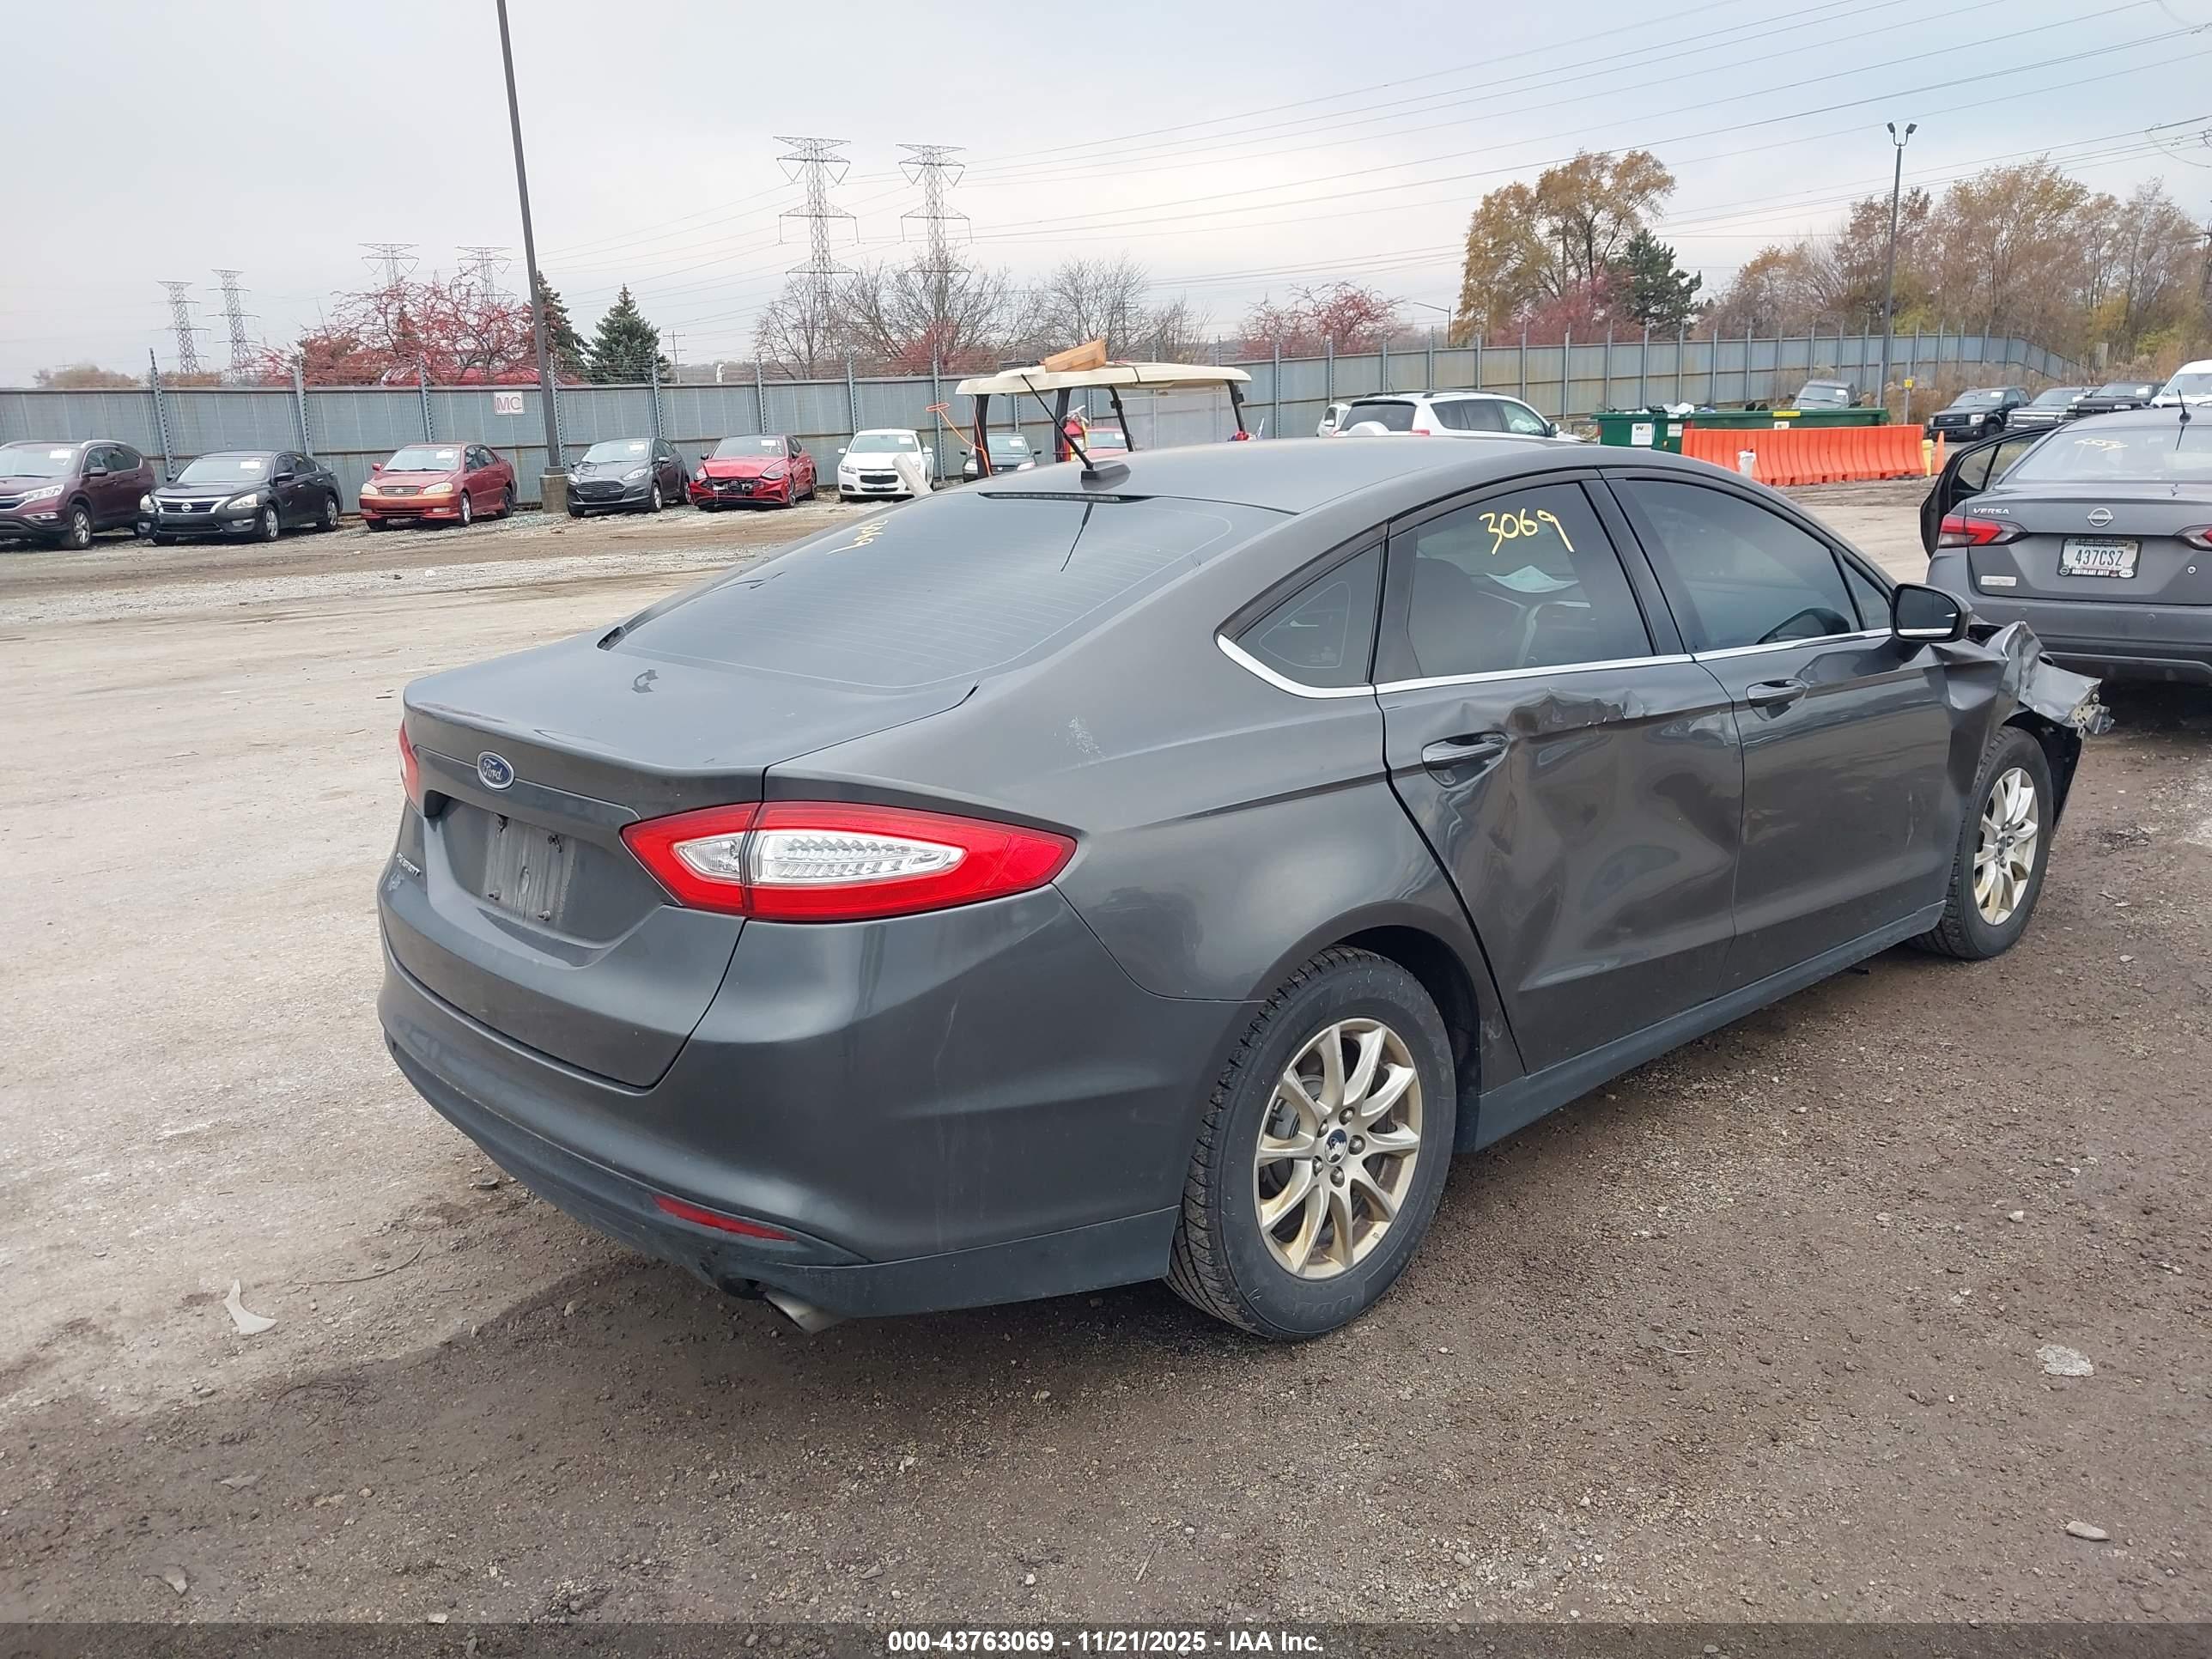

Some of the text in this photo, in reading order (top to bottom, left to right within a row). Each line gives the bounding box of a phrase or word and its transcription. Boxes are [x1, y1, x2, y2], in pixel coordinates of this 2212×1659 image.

[496, 397, 522, 410] MC
[1479, 507, 1575, 556] 3069
[2075, 549, 2124, 567] 437CSZ
[482, 757, 504, 782] Ford
